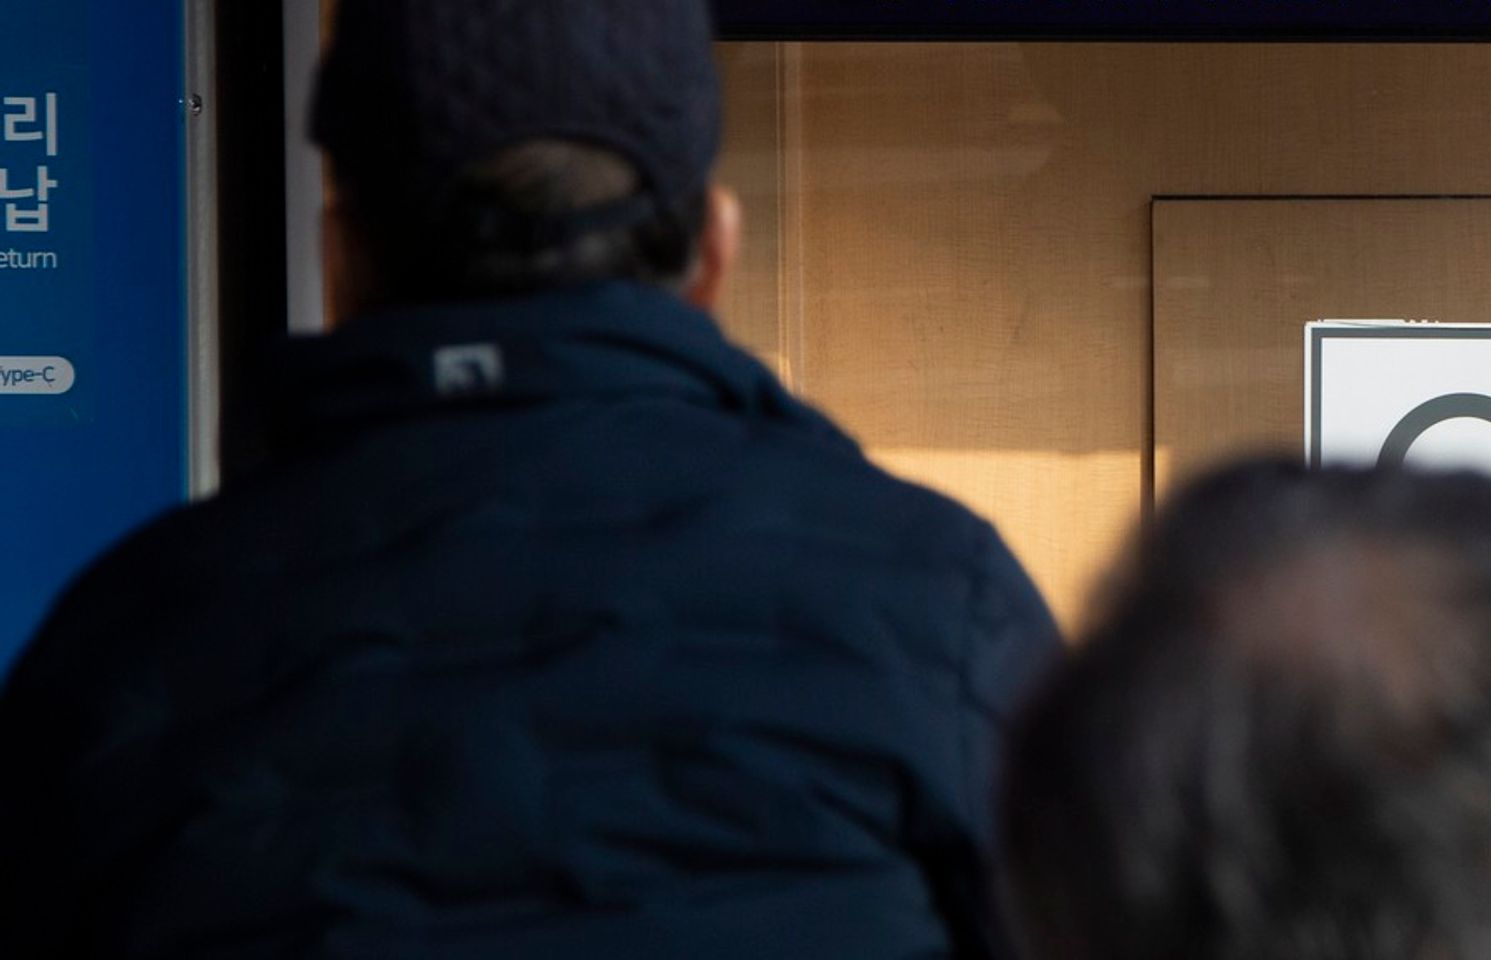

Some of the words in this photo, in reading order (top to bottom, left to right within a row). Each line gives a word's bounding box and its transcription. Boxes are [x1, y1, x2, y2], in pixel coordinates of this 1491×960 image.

[3, 92, 58, 157] 리
[0, 165, 59, 233] 납
[0, 248, 58, 269] eturn
[0, 366, 55, 386] ype-C
